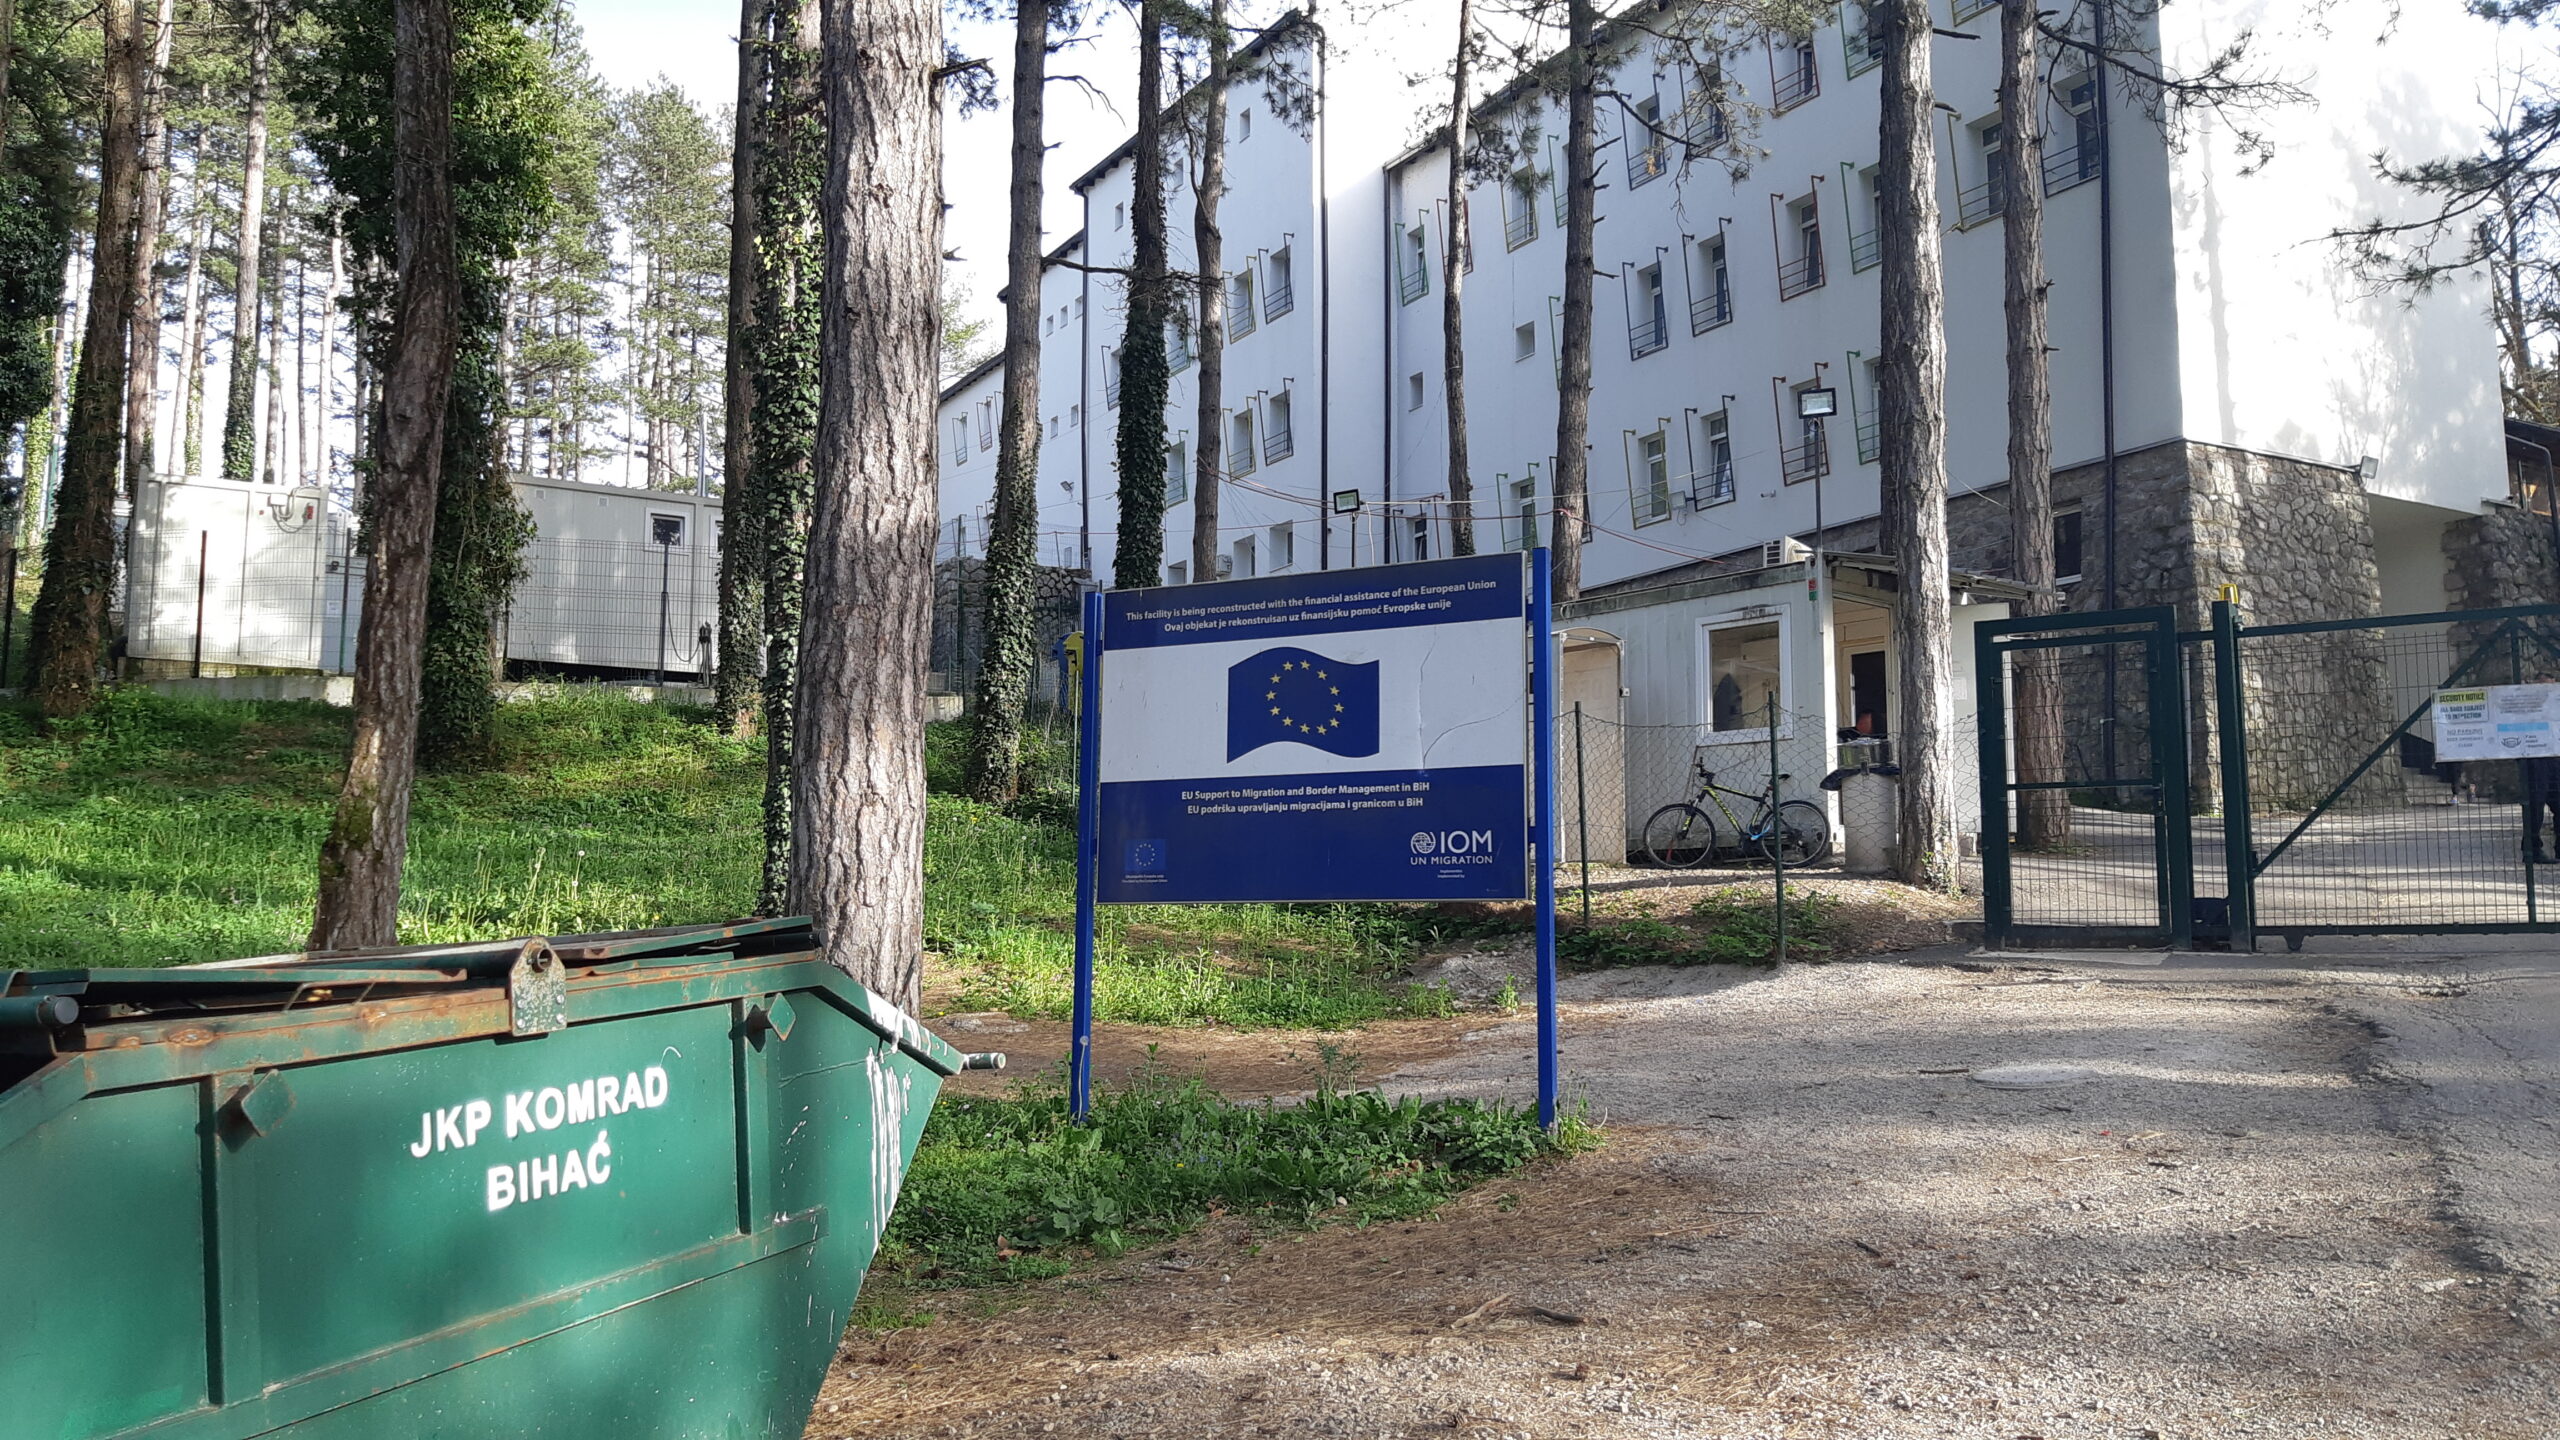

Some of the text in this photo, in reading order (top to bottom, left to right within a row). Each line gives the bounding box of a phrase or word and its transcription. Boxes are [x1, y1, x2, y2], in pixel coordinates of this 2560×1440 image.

[1126, 580, 1497, 621] This facility is being reconstructed with the financial assistance of the European Union
[1164, 599, 1451, 633] Ovaj objekat je rekonstruisan uz finansijsku pomoć Evropske unije
[2466, 692, 2485, 701] NOTICE
[1181, 782, 1430, 801] EU Support to Migration and Border Management in BiH
[1187, 805, 1199, 814] EU
[1201, 803, 1236, 815] podrška
[1237, 802, 1288, 814] upravljanju
[1290, 800, 1345, 813] migracijama
[1352, 799, 1396, 810] granicom
[1398, 799, 1404, 807] u
[1406, 798, 1423, 807] BiH
[1440, 830, 1493, 854] IOM
[1410, 855, 1493, 865] UN MIGRATION
[410, 1066, 668, 1158] JKP KOMRAD
[487, 1130, 611, 1212] BIHAĆ
